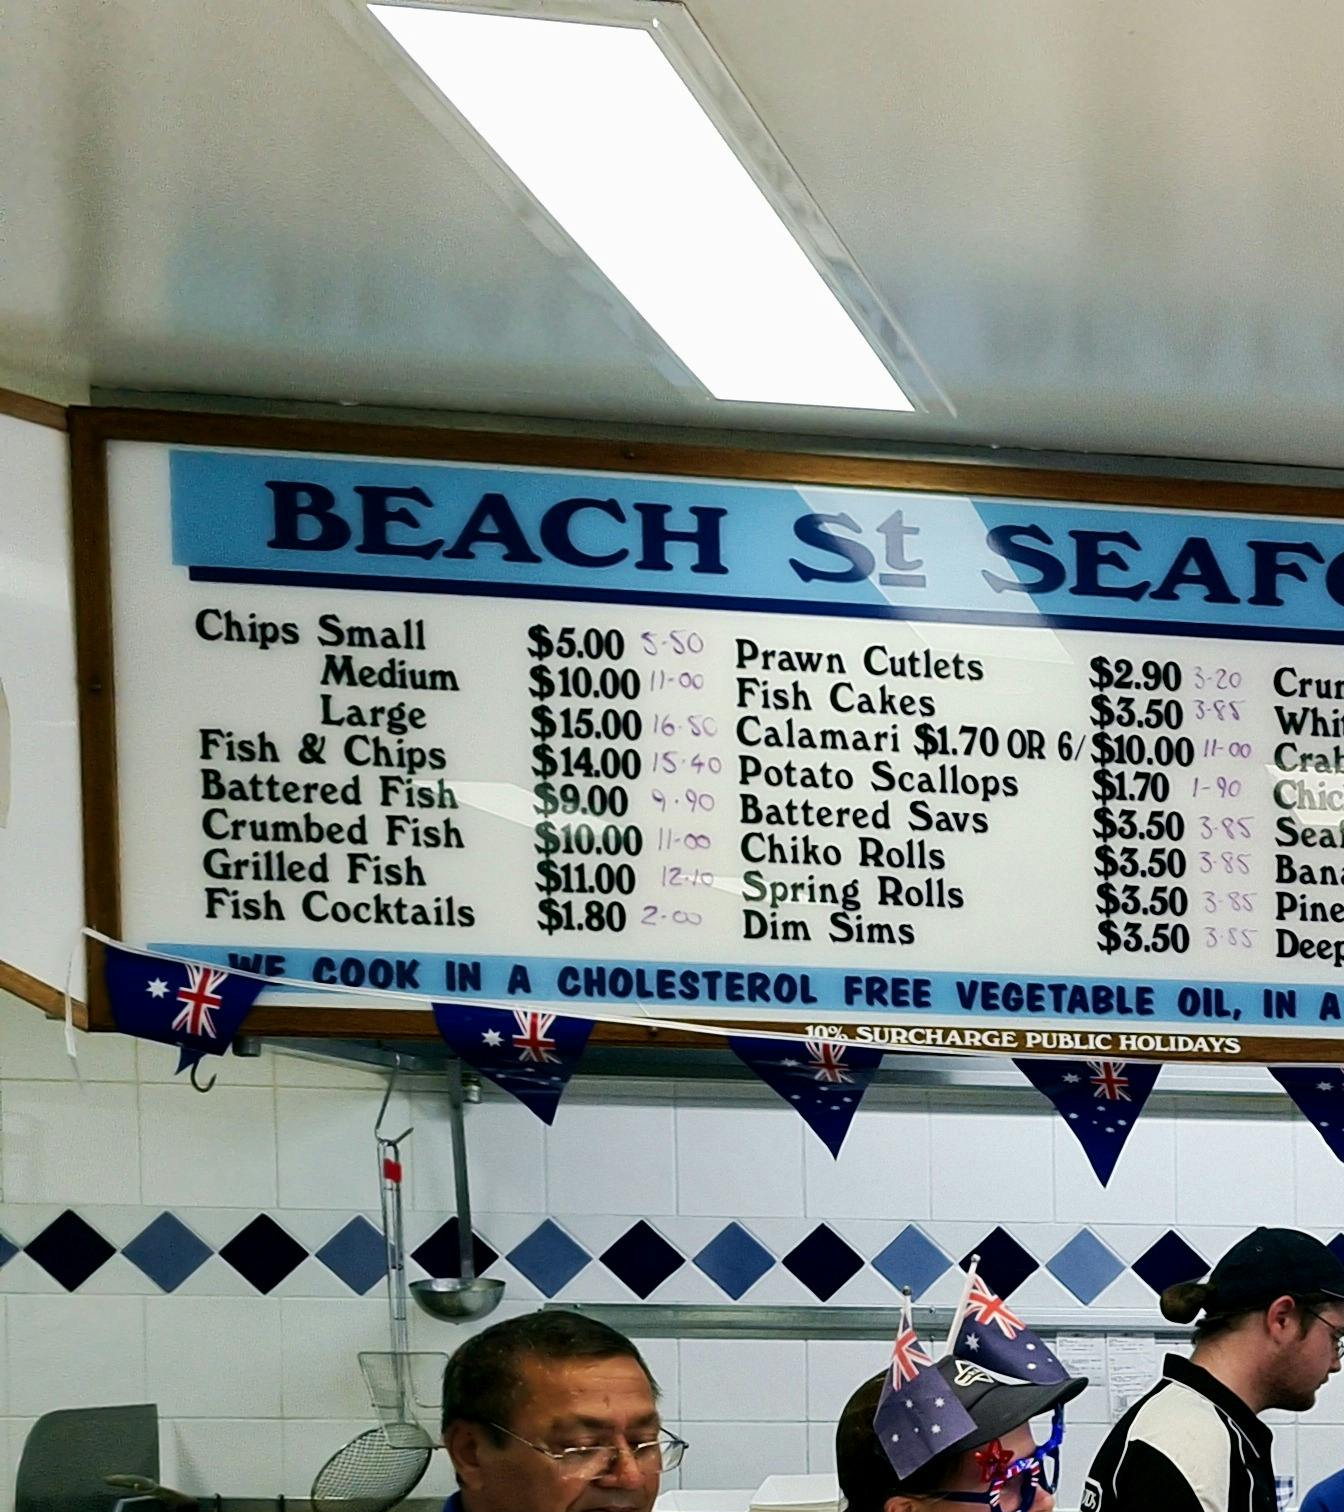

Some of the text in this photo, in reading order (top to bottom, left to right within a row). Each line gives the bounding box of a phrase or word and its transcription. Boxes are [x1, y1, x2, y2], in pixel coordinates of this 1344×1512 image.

[265, 481, 729, 573] BEACH
[789, 510, 927, 588] St
[196, 609, 624, 661] Chips Small $5.00
[320, 654, 640, 701] Medium $10.00
[736, 639, 1181, 692] Prawn Cutlets $2.90
[321, 694, 642, 742] Large $15.00
[200, 729, 641, 780] Fish & Chips $14.00
[205, 887, 626, 935] Fish Cocktails $1.80
[743, 871, 1187, 918] Spring Rolls $3.50
[743, 909, 1189, 955] Dim Sims $3.50
[309, 957, 421, 990] COOK
[445, 960, 482, 992] IN
[507, 964, 532, 995] A
[557, 966, 818, 1004] CHOLESTEROL
[844, 976, 931, 1008] FREE
[956, 980, 1155, 1016] VEGETABLE
[1177, 987, 1242, 1021] OIL,
[1263, 989, 1297, 1019] IN
[1319, 992, 1341, 1021] A
[804, 1024, 1241, 1053] 10% SURCHARGE PUBLIC HOLIDAYS
